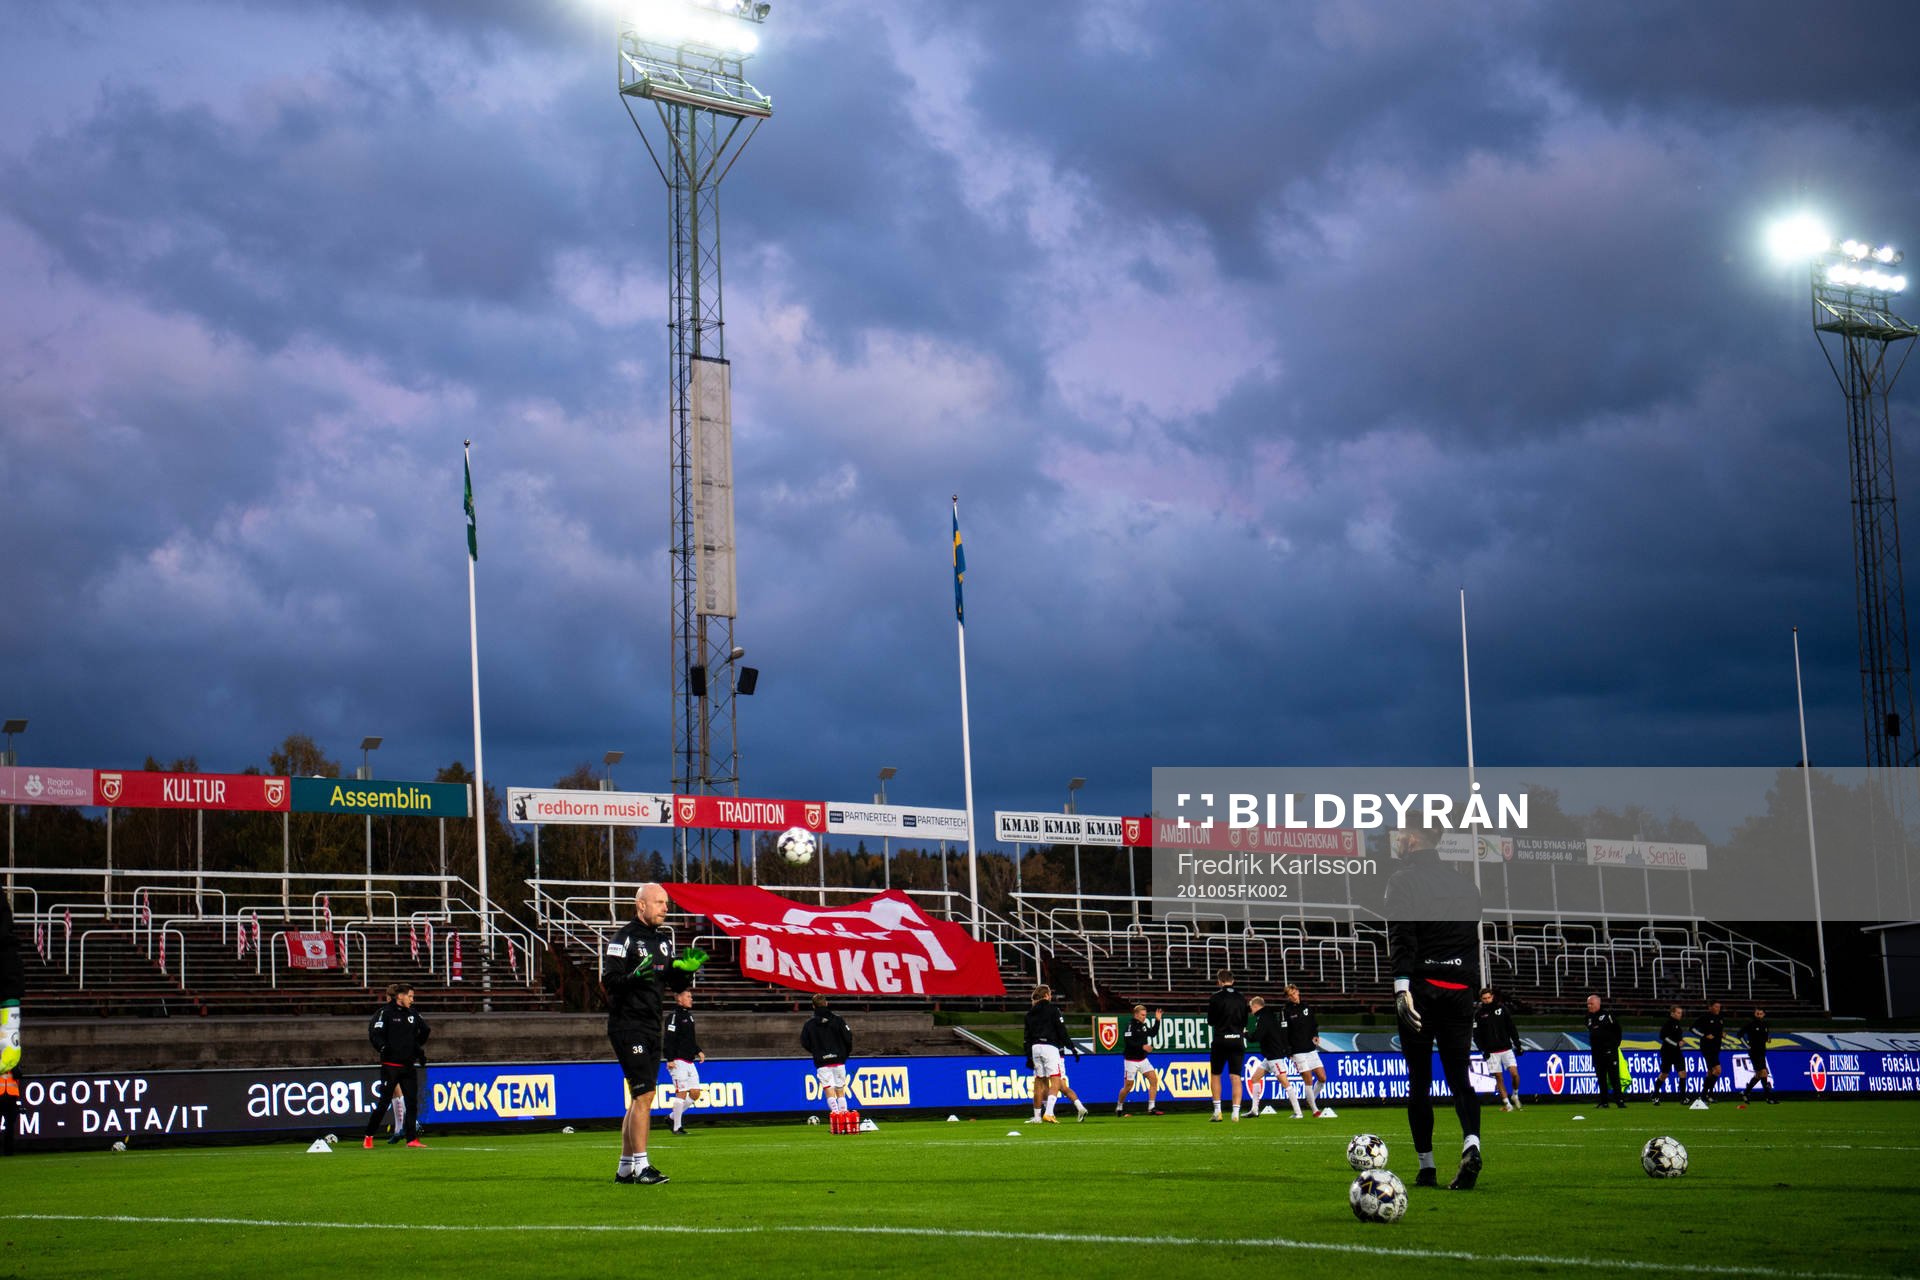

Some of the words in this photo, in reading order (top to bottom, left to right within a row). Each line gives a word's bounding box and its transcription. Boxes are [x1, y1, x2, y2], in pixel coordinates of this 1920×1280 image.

[47, 777, 73, 788] Region
[163, 778, 226, 803] KULTUR
[330, 785, 432, 809] Assemblin
[538, 800, 599, 816] redhorn
[603, 802, 650, 817] music
[717, 801, 785, 825] TRADITION
[844, 810, 897, 824] PARTNERTECH
[917, 815, 967, 829] PARTNERTECH
[1002, 818, 1040, 832] KMAB
[1044, 819, 1081, 834] KMAB
[1087, 821, 1122, 836] KMAB
[1160, 824, 1210, 845] AMBITION
[1264, 831, 1282, 847] MOT
[1283, 832, 1338, 849] ALLSVENSKAN
[632, 1045, 644, 1054] 38
[1337, 1056, 1410, 1076] FÖRSÄLJNIN
[1829, 1054, 1860, 1071] HUSBILS
[1320, 1081, 1375, 1099] HUSBILAR
[1379, 1080, 1387, 1098] &
[1570, 1077, 1600, 1094] LANDE
[1832, 1076, 1860, 1092] LANDET
[1869, 1076, 1914, 1091] HUSBILAR
[16, 1079, 148, 1106] OGOTYP
[83, 1105, 208, 1133] DATA/IT
